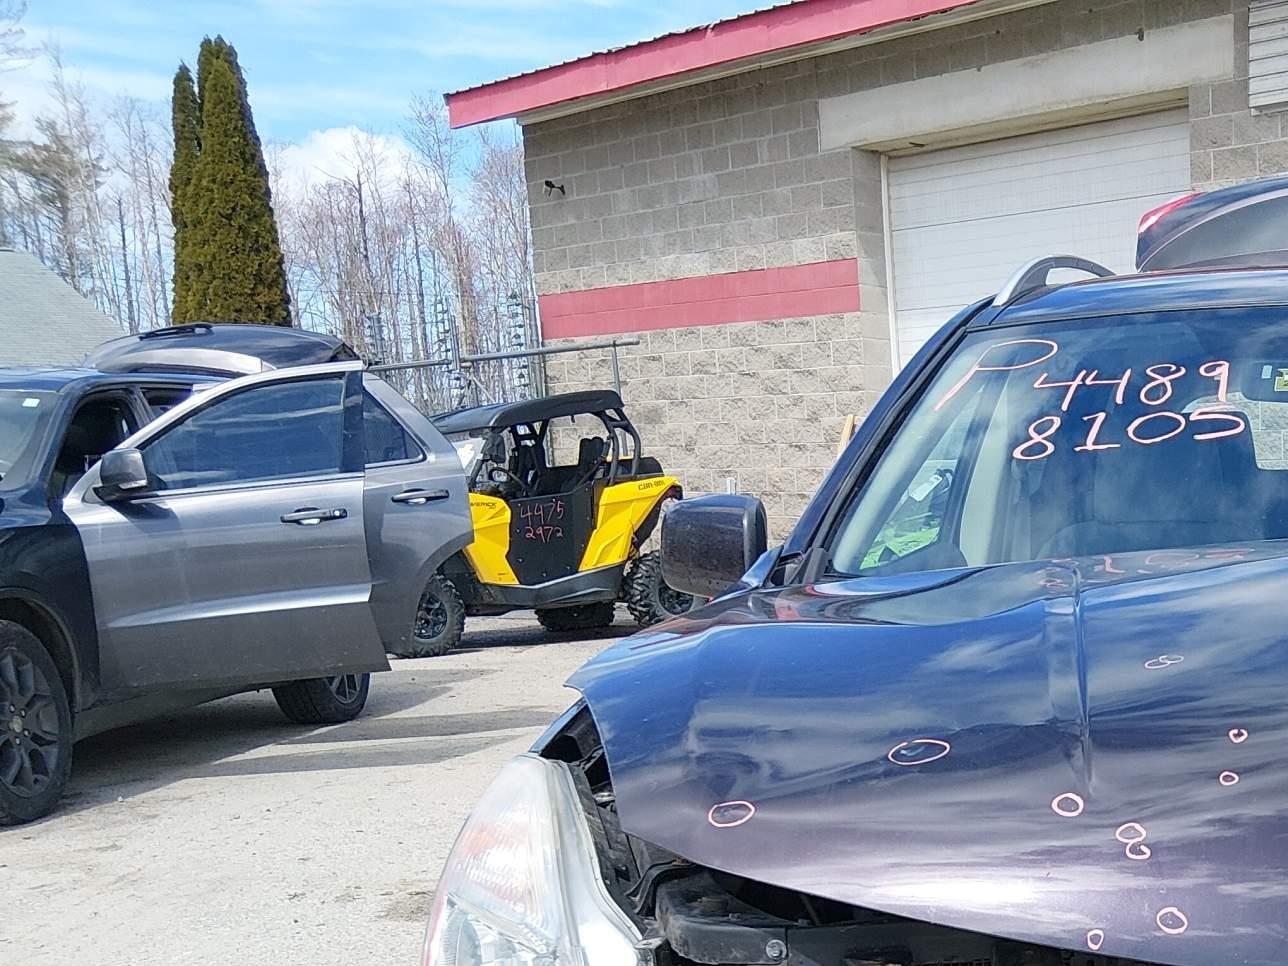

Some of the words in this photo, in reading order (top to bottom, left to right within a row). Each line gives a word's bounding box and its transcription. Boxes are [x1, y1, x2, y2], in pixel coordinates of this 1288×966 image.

[1033, 360, 1231, 411] 4489
[1012, 405, 1246, 460] 8105
[520, 500, 565, 527] 4475
[525, 526, 564, 544] 2972
